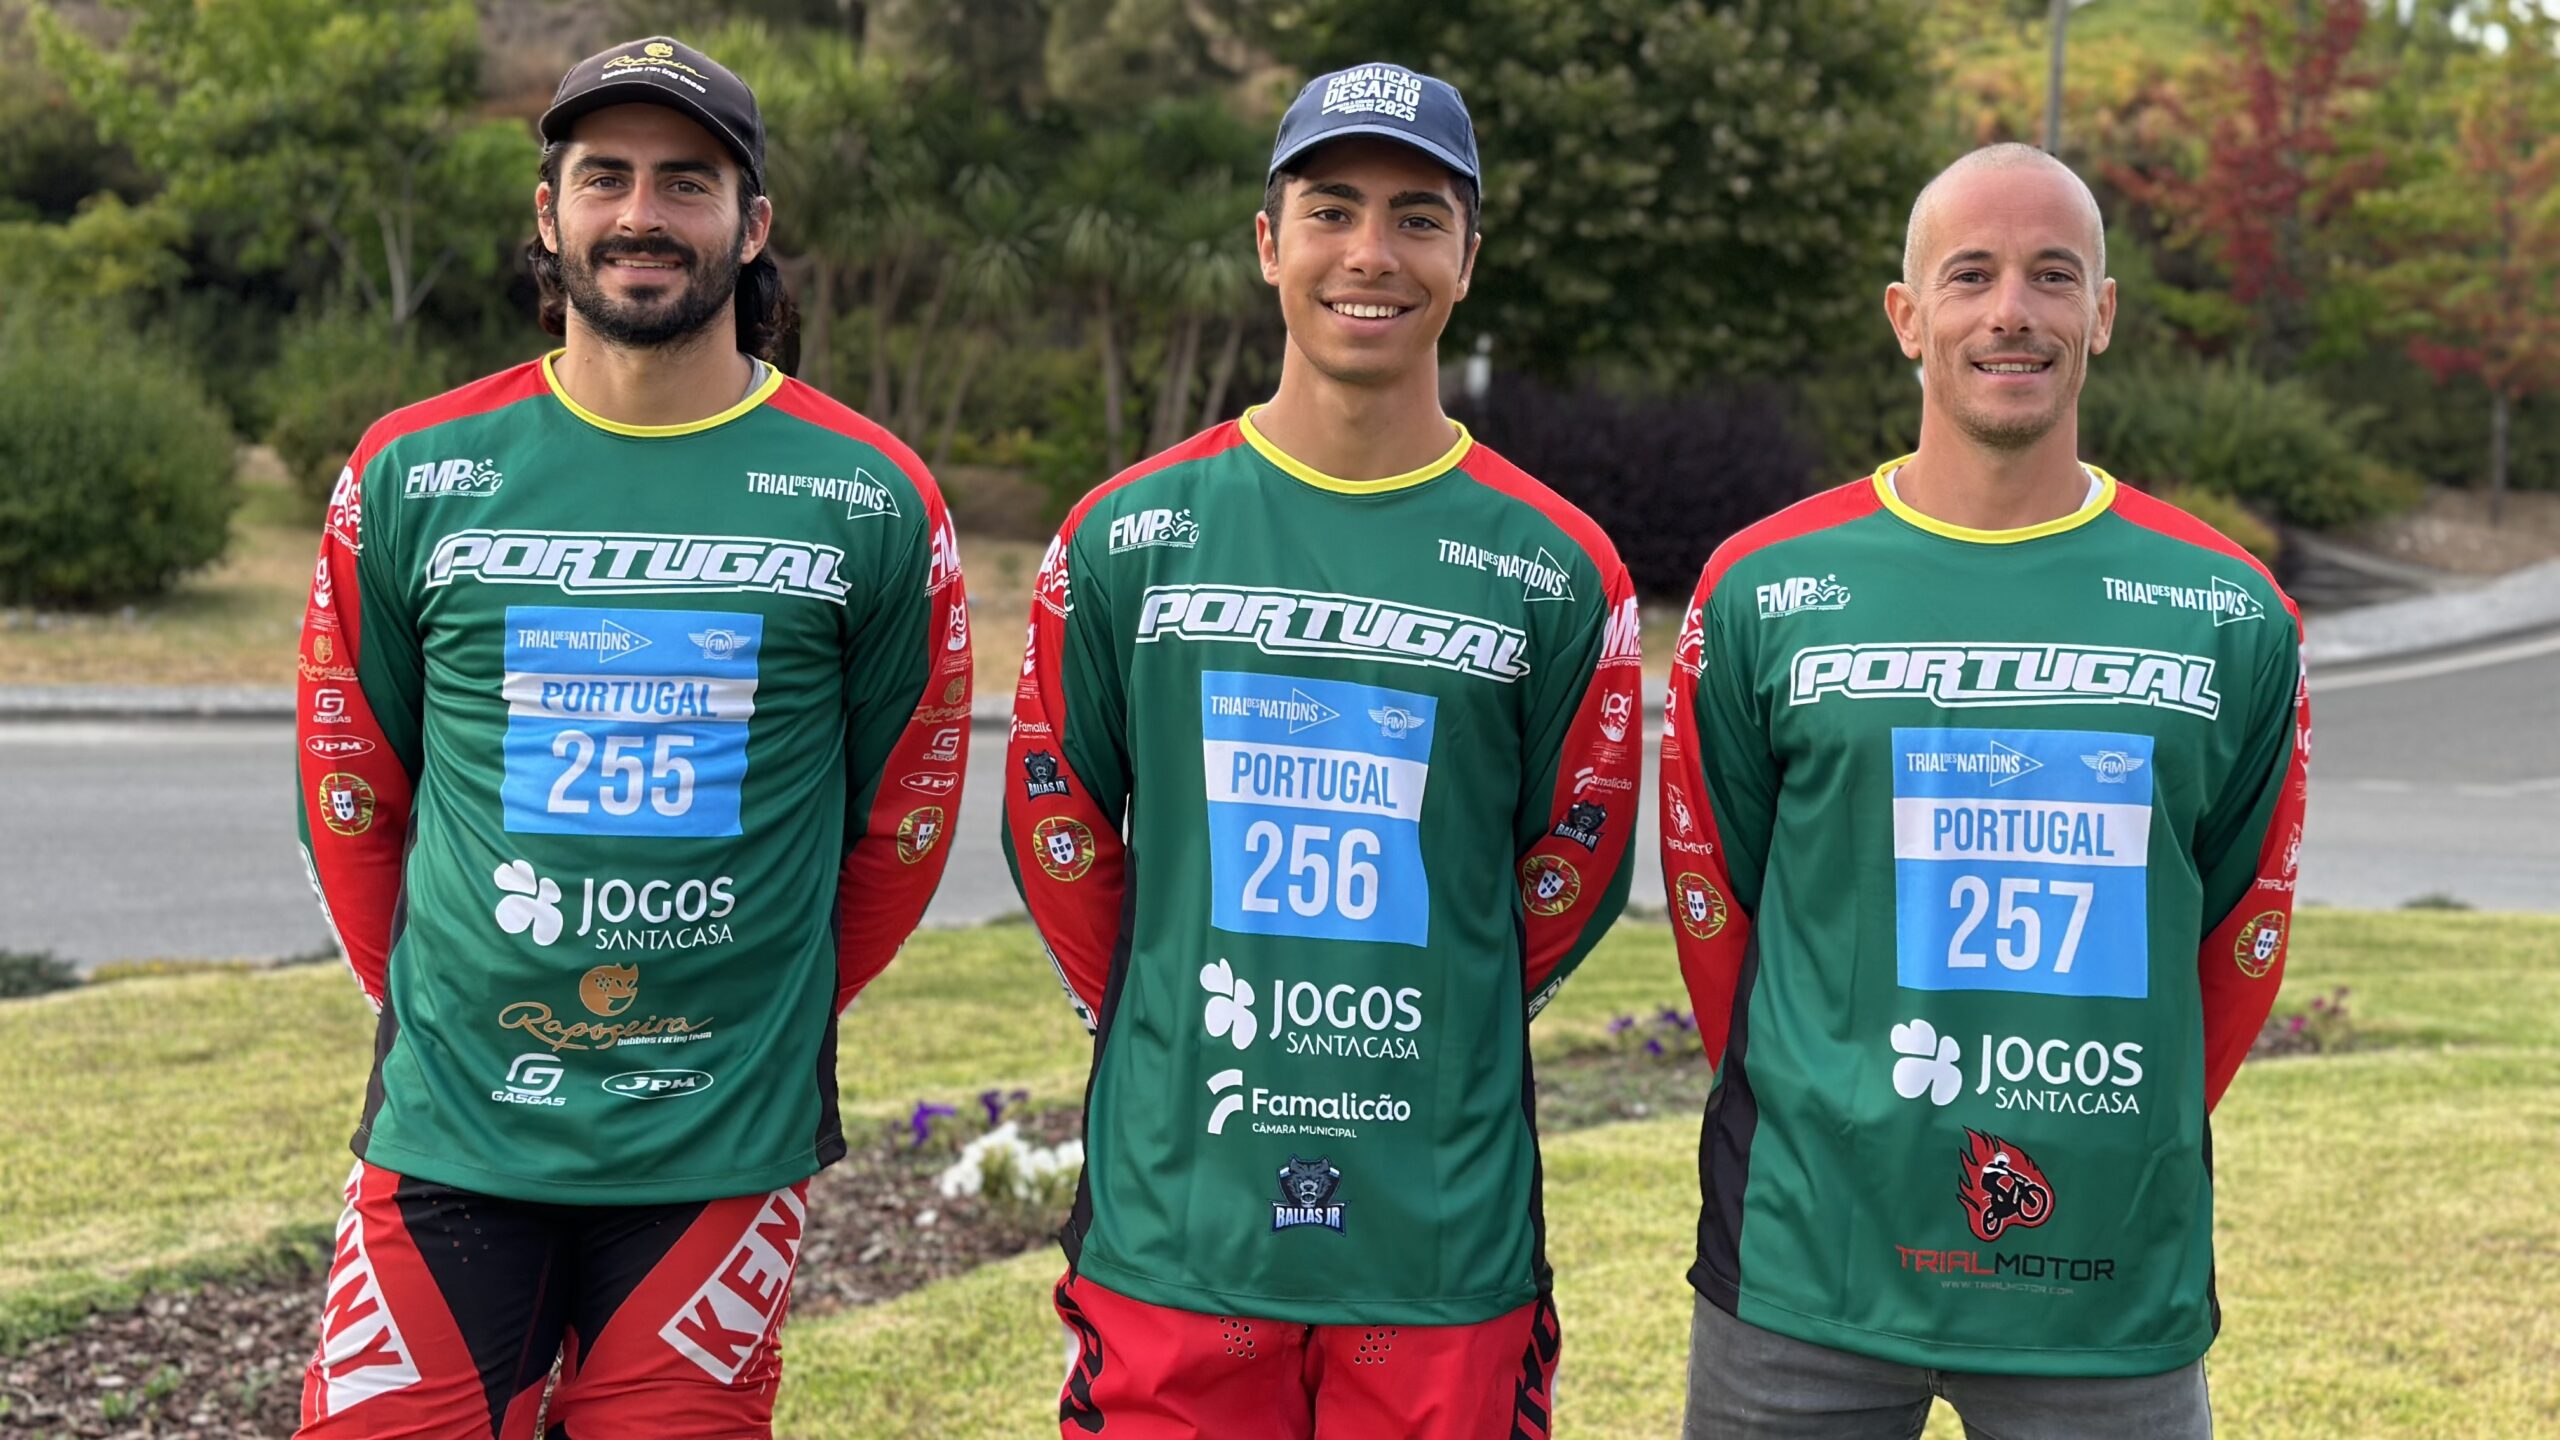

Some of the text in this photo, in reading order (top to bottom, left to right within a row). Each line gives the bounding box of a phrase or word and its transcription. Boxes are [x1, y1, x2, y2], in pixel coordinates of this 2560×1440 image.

[1322, 79, 1420, 109] DESAFIO
[1374, 98, 1417, 122] 2025
[404, 459, 474, 494] FMP
[747, 472, 887, 511] TRIAL DES NATIONS
[1109, 508, 1173, 550] FMP
[426, 529, 852, 605] PORTUGAL
[1438, 538, 1566, 597] TRIAL DES NATIONS
[1756, 576, 1818, 615] FMP
[2102, 576, 2248, 617] TRIAL DES NATIONS
[517, 629, 557, 649] TRIAL
[568, 631, 631, 651] NATIONS
[709, 638, 730, 651] FIM
[1136, 583, 1530, 683] PORTUGAL
[541, 681, 718, 718] PORTUGAL
[1790, 642, 2220, 721] PORTUGAL
[312, 715, 351, 724] GASGAS
[1211, 695, 1250, 716] TRIAL
[1259, 699, 1319, 723] NATIONS
[546, 728, 696, 818] 255
[1231, 750, 1398, 810] PORTUGAL
[1906, 752, 1948, 772] TRIAL
[1956, 753, 2020, 774] NATIONS
[2101, 762, 2124, 774] FIM
[1933, 807, 2115, 857] PORTUGAL
[1241, 819, 1380, 920] 256
[576, 875, 736, 937] JOGOS
[1947, 874, 2094, 973] 257
[595, 923, 734, 951] SANTACASA
[1268, 980, 1423, 1040] JOGOS
[1286, 1031, 1420, 1060] SANTACASA
[1975, 1034, 2143, 1095] JOGOS
[491, 1091, 567, 1107] GASGAS
[615, 1076, 696, 1092] JPM
[1995, 1086, 2140, 1115] SANTACASA
[1251, 1121, 1358, 1138] CÂMARA MUNICIPAL
[1275, 1206, 1340, 1229] BALLAS JR
[675, 1194, 802, 1370] KEN
[1895, 1243, 2115, 1282] TRIALMOTOR
